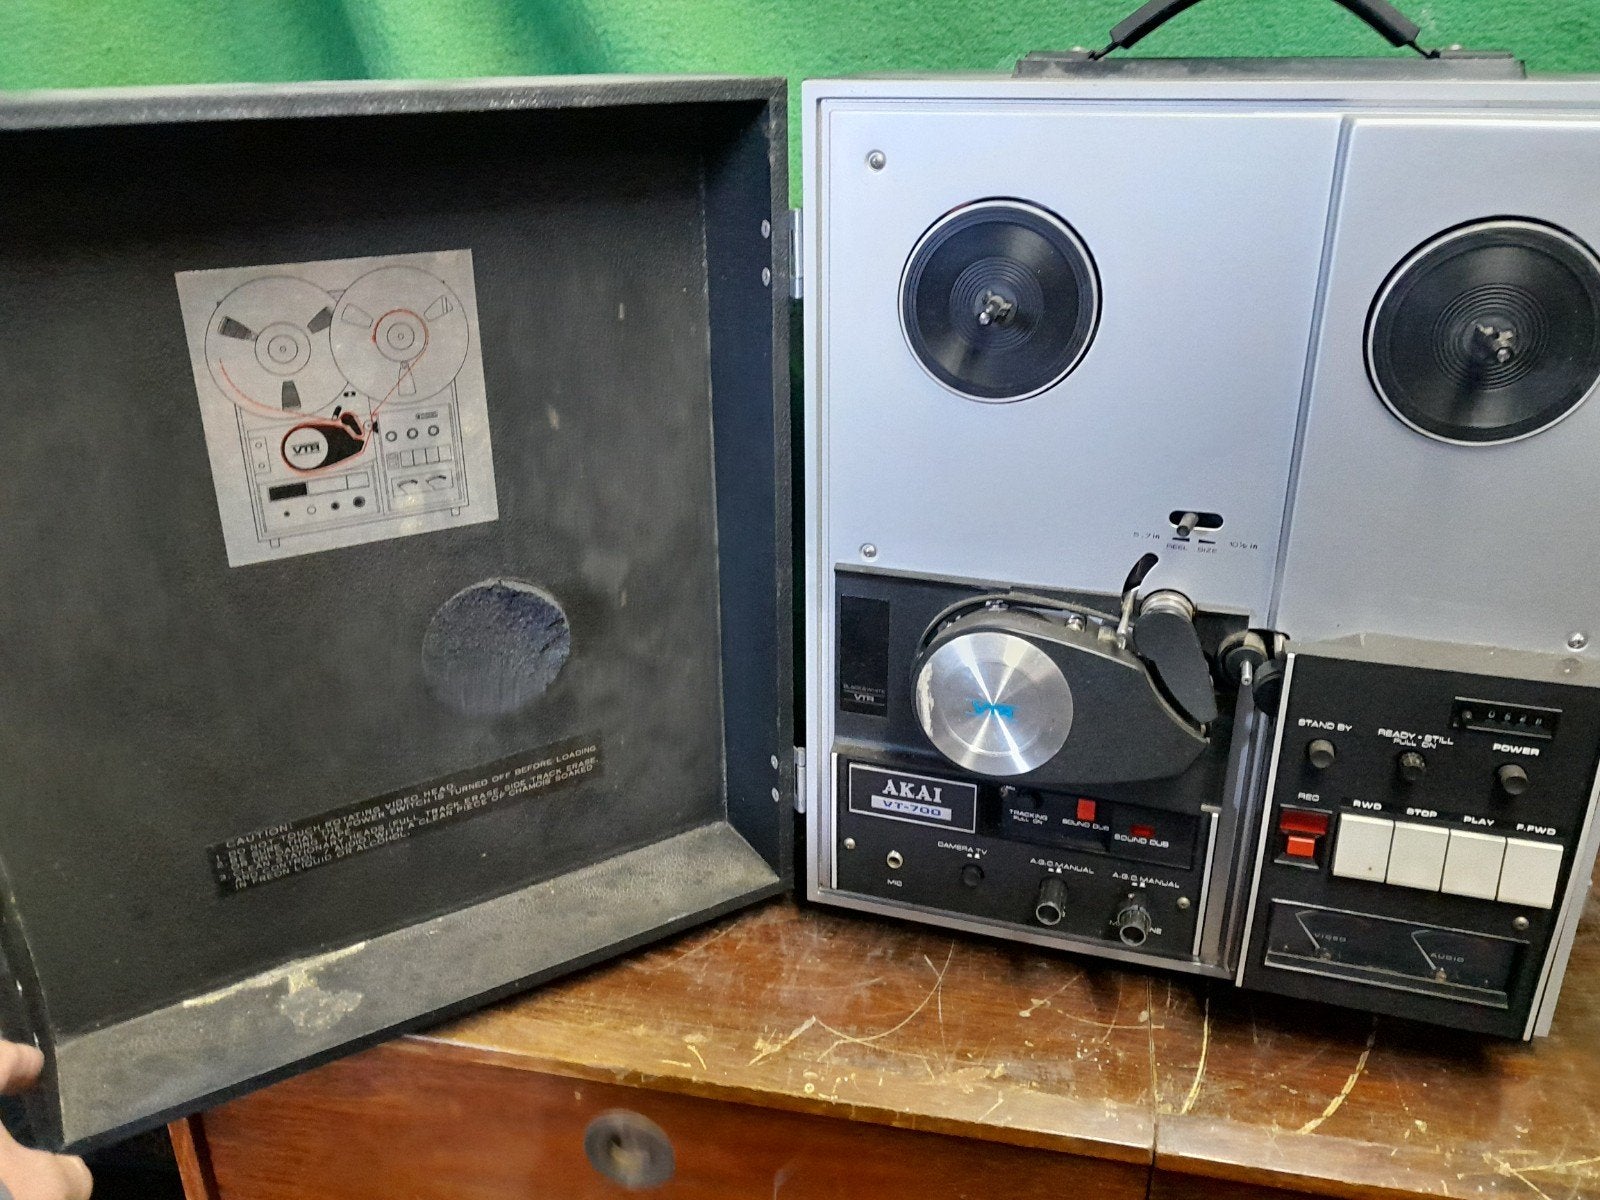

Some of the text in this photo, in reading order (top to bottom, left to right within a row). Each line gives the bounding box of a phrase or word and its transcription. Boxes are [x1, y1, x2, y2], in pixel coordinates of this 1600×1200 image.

[291, 442, 321, 455] VTR
[1298, 718, 1353, 732] STAND BY
[1378, 728, 1454, 746] READY STILL
[1393, 738, 1437, 750] PULL ON
[1493, 742, 1540, 757] POWER
[450, 779, 487, 795] TURNED
[491, 771, 511, 782] OFF
[514, 758, 551, 775] BEFORE
[556, 745, 595, 762] LOADING
[504, 778, 525, 791] SIDE
[529, 767, 561, 783] TRACK
[418, 809, 453, 825] CLEAN
[508, 777, 550, 796] CHAMOIS
[555, 763, 592, 781] SOAKED
[882, 778, 942, 803] AKAI
[384, 794, 418, 809] VIDEO
[883, 799, 942, 816] VT-700
[1353, 799, 1383, 811] RWD
[1009, 808, 1048, 822] TRACKING
[1406, 807, 1438, 818] STOP
[1062, 817, 1090, 829] SOUND
[1463, 815, 1495, 827] PLAY
[1516, 823, 1557, 837] F.FWD
[937, 840, 988, 856] CAMERA TV
[1114, 833, 1169, 849] SOUND DUB
[1054, 861, 1095, 875] MANUAL
[887, 878, 903, 887] MIC
[1139, 876, 1180, 889] MANUAL
[1430, 952, 1465, 963] AUDIO
